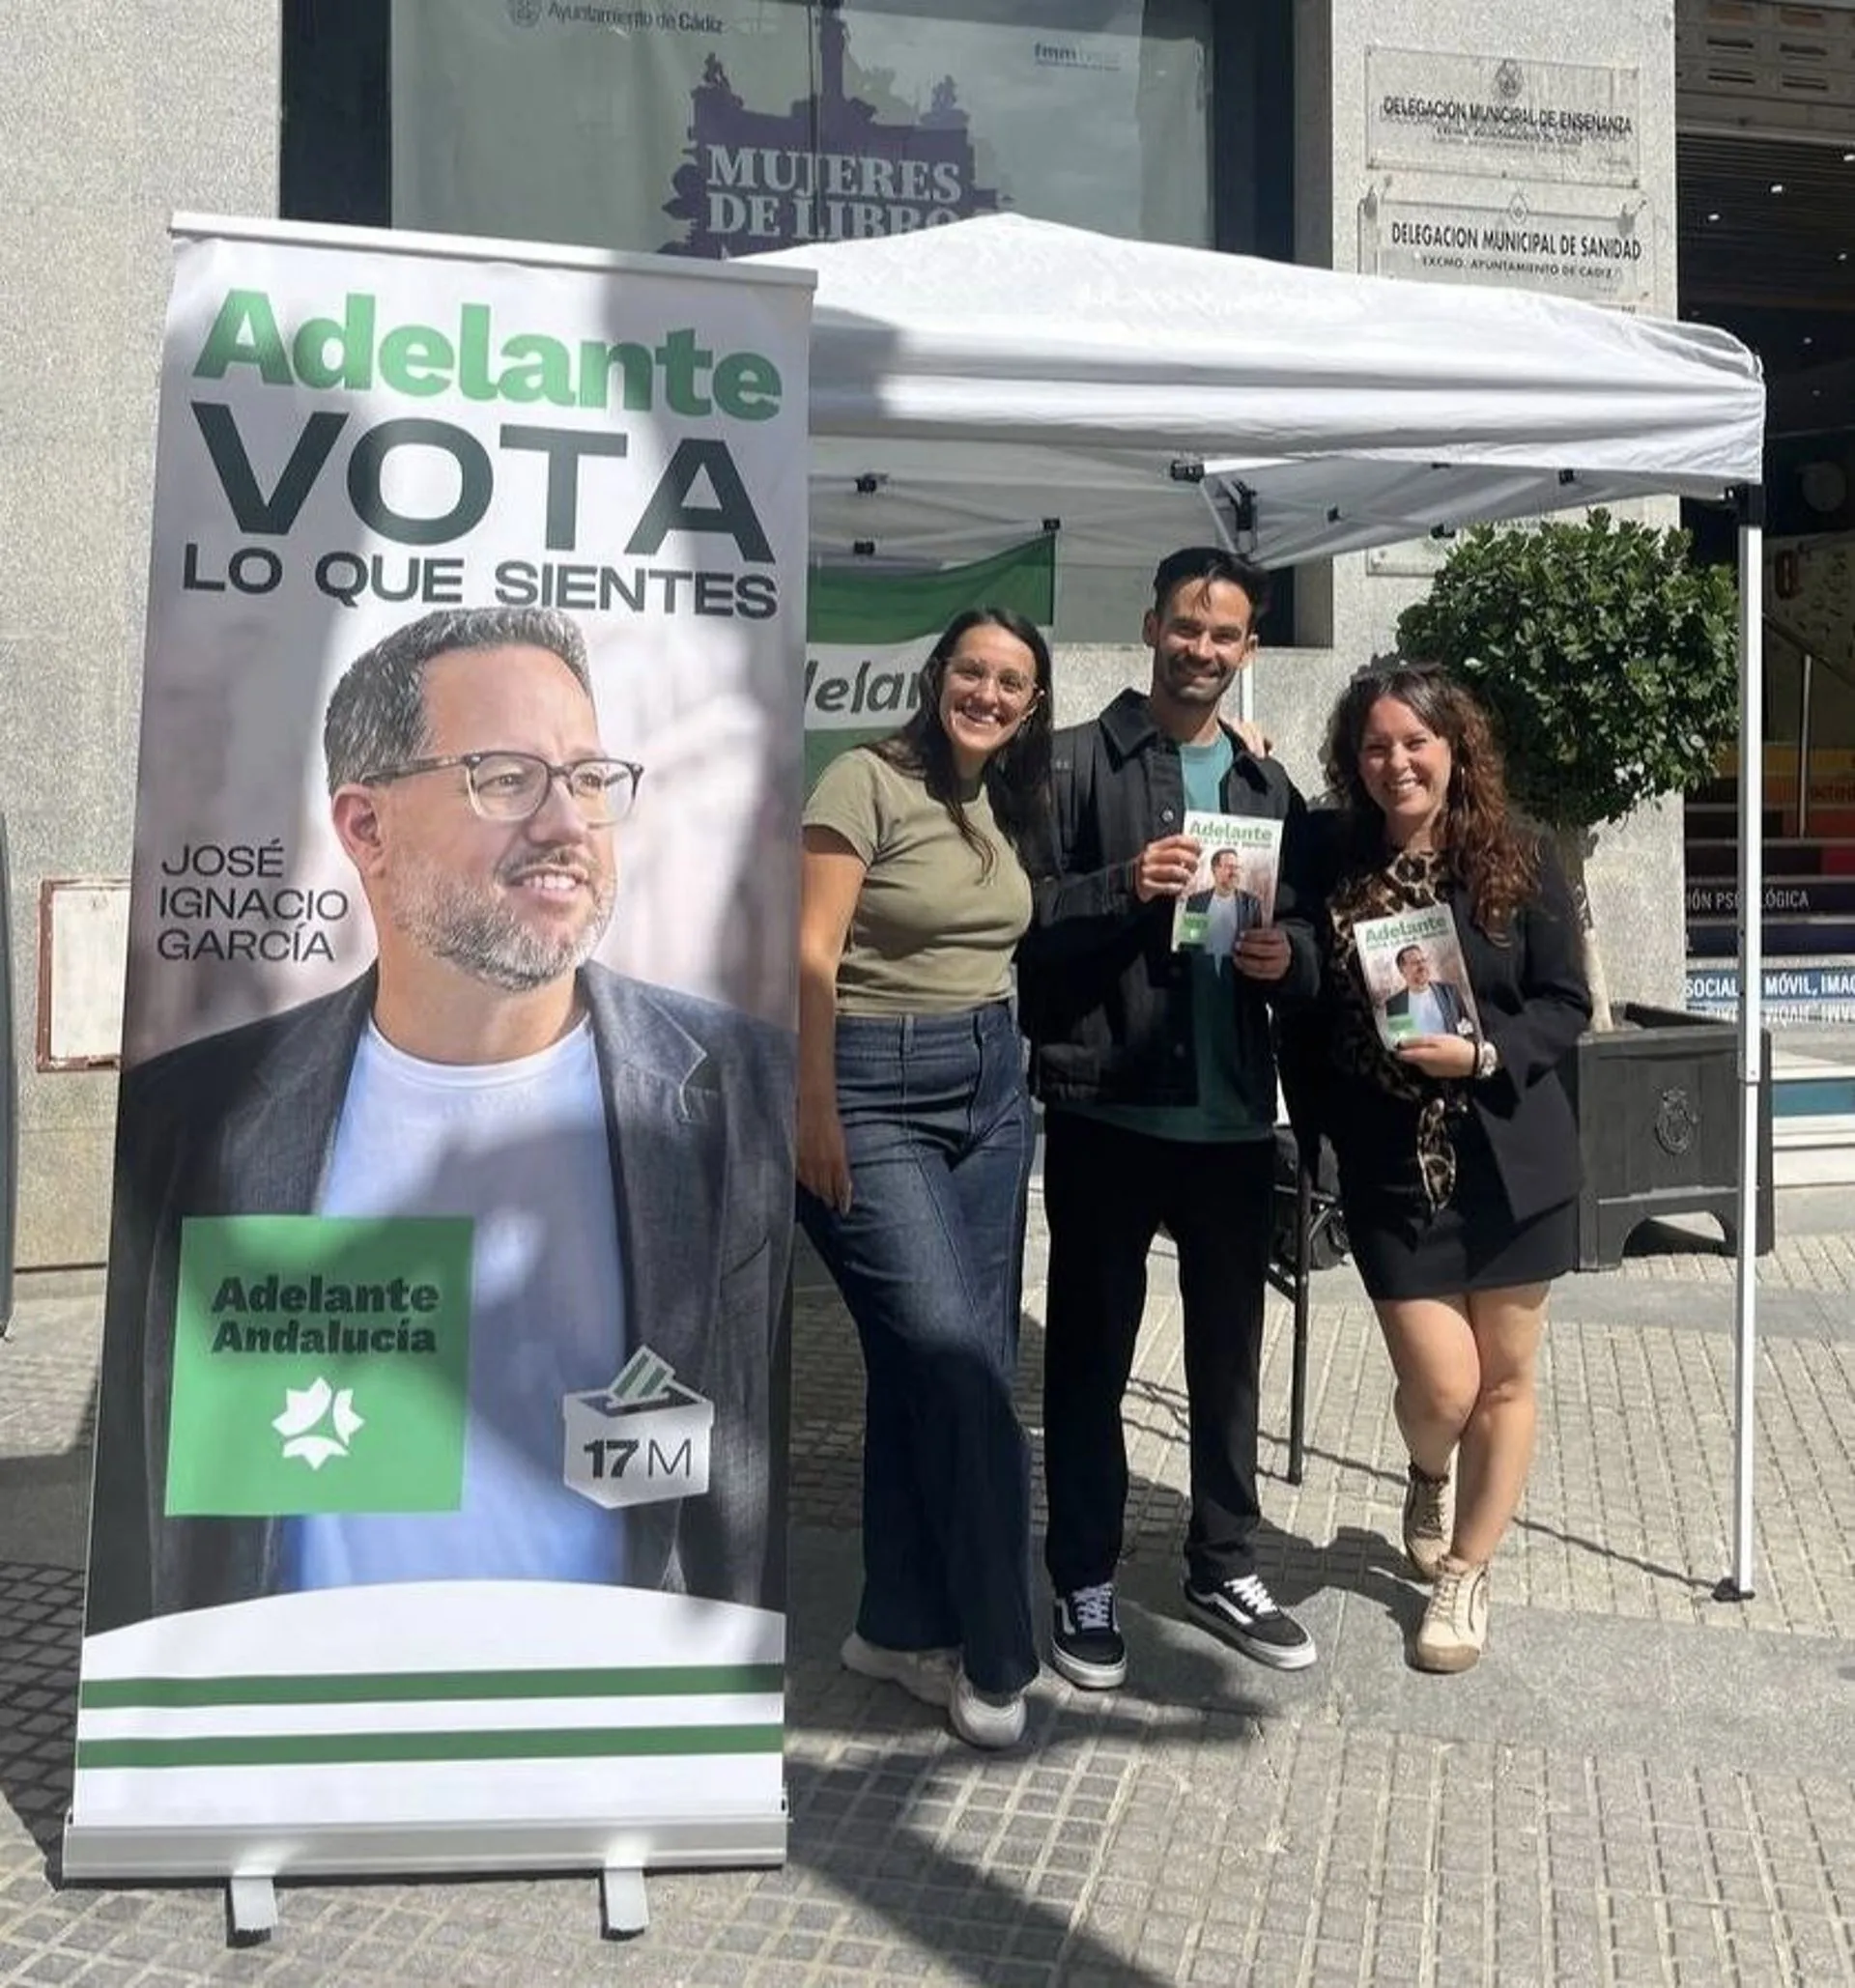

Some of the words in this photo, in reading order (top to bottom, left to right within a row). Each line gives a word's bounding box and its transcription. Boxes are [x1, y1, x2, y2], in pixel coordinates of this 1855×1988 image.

[657, 14, 676, 31] de
[1539, 109, 1557, 128] DE
[707, 144, 962, 205] MUJERES
[707, 192, 782, 238] DE
[1392, 221, 1479, 250] DELEGACION
[1482, 228, 1556, 255] MUNICIPAL
[1560, 234, 1577, 257] DE
[1581, 235, 1642, 262] SANIDAD
[192, 289, 784, 422] Adelante
[189, 400, 777, 564] VOTA
[183, 543, 284, 594] LO
[315, 551, 464, 607] QUE
[494, 560, 779, 620] SIENTES
[1189, 819, 1273, 841] Adelante
[161, 838, 284, 879] JOSÉ
[158, 886, 351, 922] IGNACIO
[157, 923, 335, 963] GARCÍA
[1365, 917, 1447, 944] Adelante
[212, 1276, 441, 1317] Adelante
[211, 1315, 437, 1356] Andalucía
